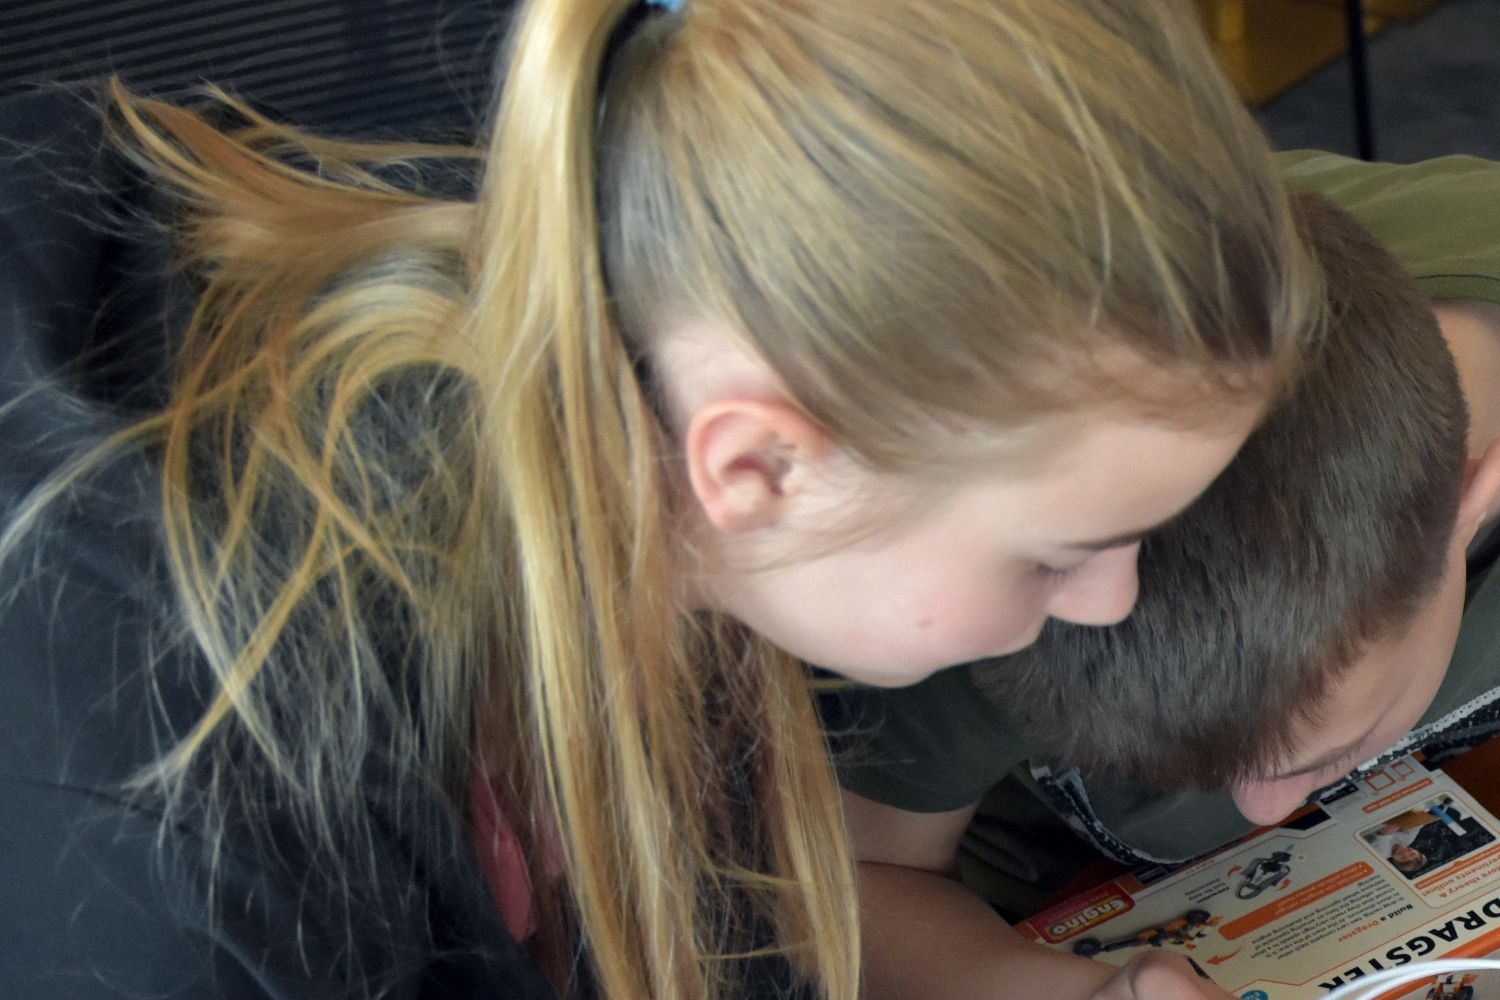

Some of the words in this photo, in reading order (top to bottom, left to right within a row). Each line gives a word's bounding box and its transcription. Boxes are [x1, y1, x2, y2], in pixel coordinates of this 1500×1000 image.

[1050, 898, 1125, 936] Engino
[1387, 904, 1414, 918] Build
[1338, 920, 1380, 942] Dragster
